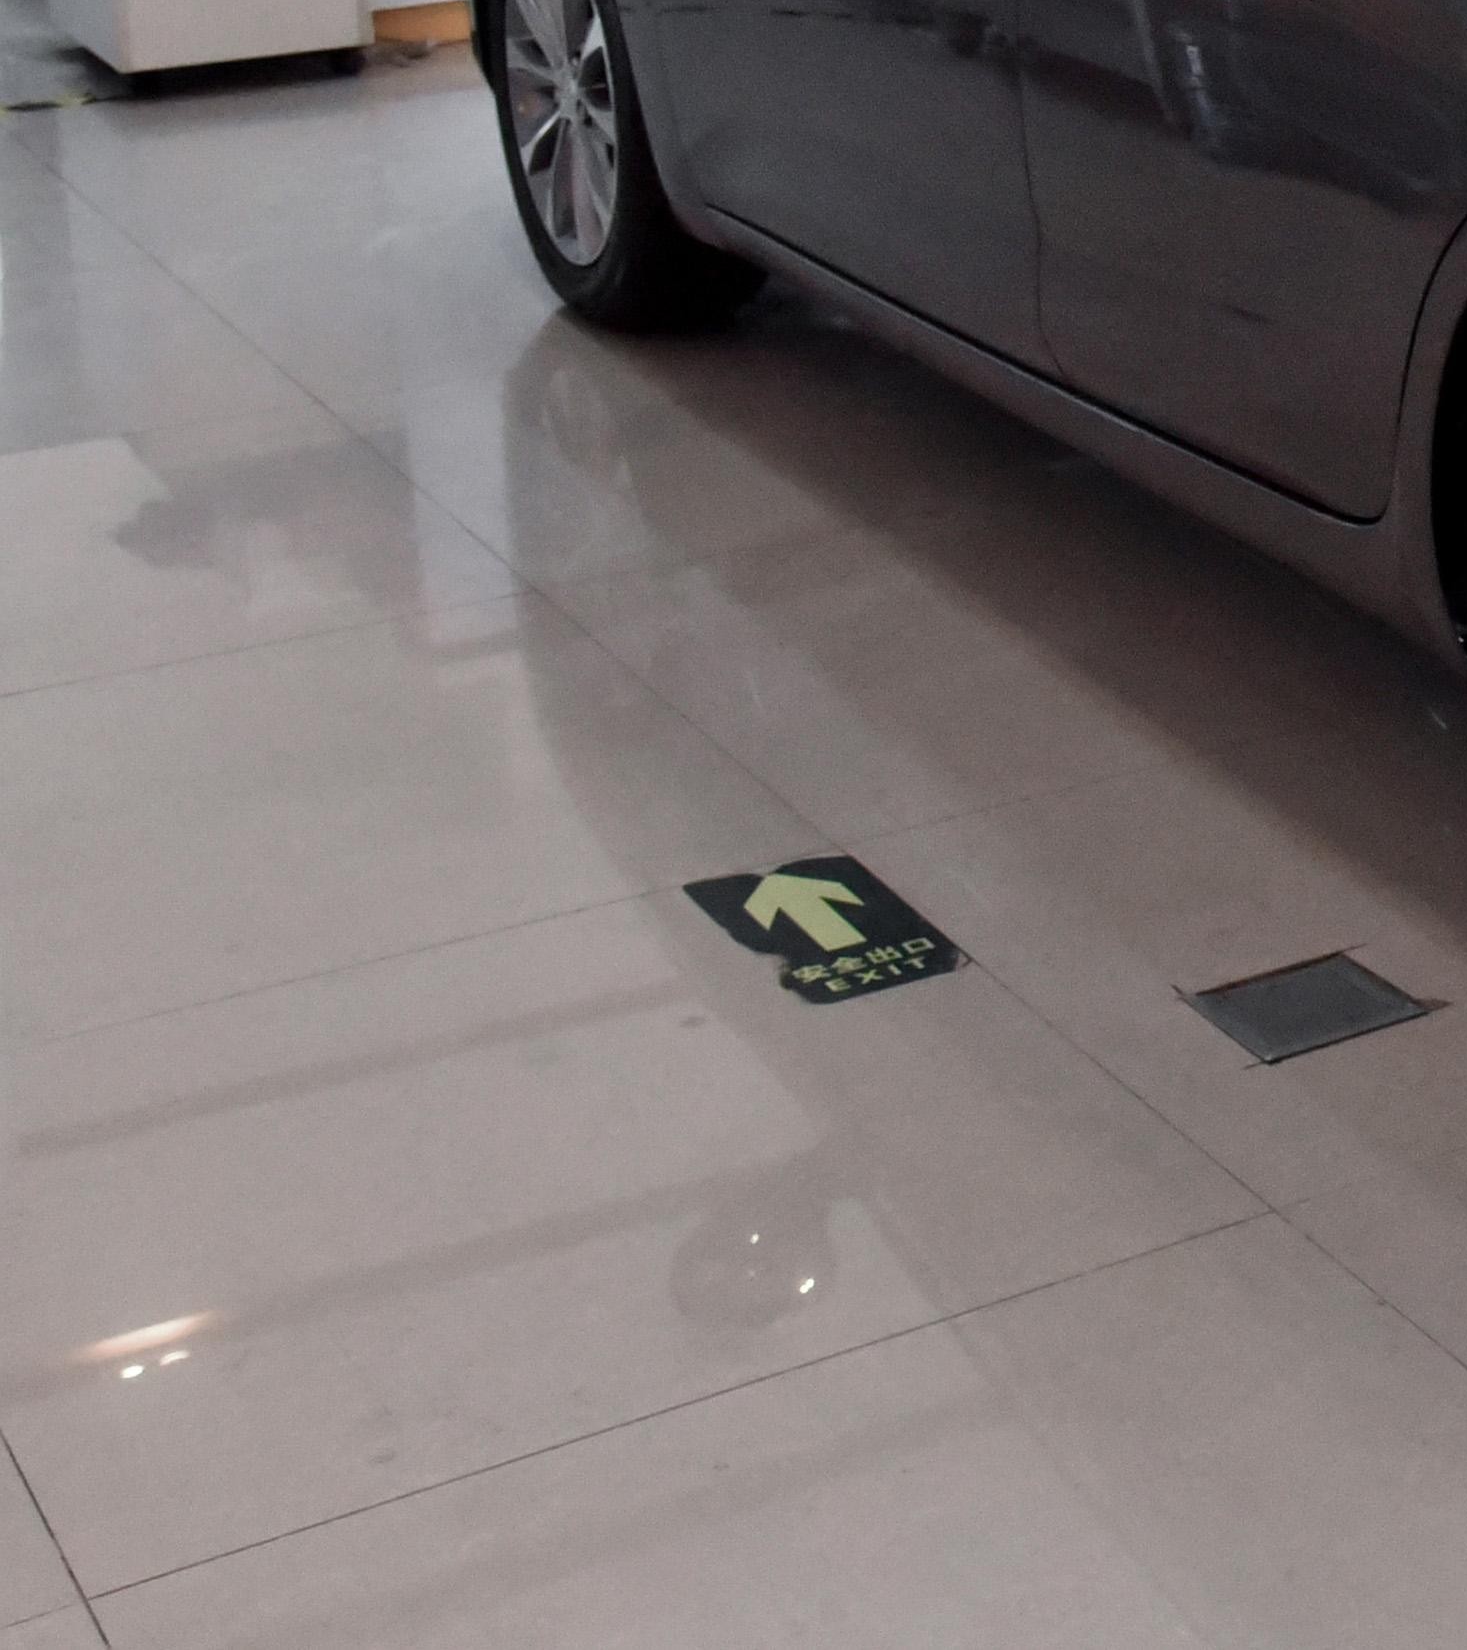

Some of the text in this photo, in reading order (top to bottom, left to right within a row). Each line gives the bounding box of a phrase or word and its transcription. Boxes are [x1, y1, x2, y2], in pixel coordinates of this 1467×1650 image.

[791, 936, 936, 984] 安全出口
[824, 955, 927, 993] EXIT
